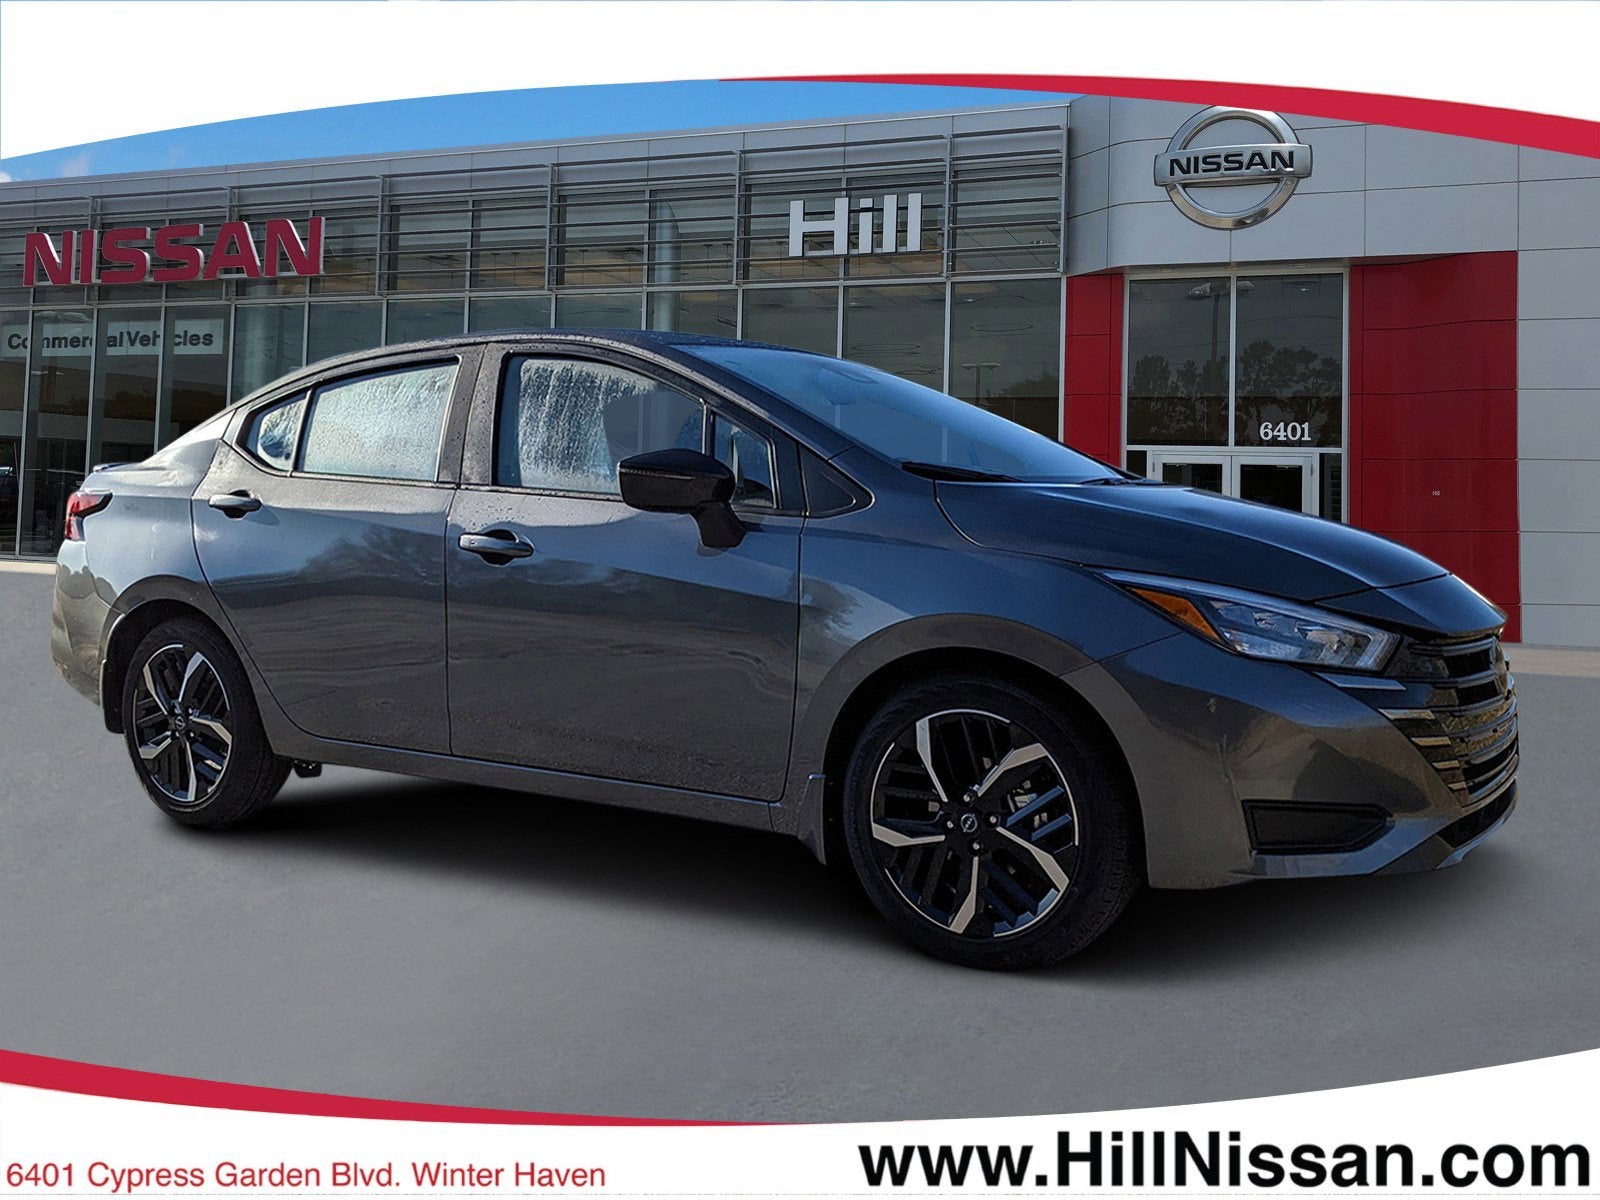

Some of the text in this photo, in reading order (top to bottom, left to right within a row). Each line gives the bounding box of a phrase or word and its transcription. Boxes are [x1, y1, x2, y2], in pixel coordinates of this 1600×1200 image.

[1169, 150, 1294, 177] NISSAN
[788, 193, 922, 257] Hill
[23, 216, 325, 287] NISSAN
[7, 329, 214, 350] Comeral Vehcles
[1259, 421, 1312, 441] 6401
